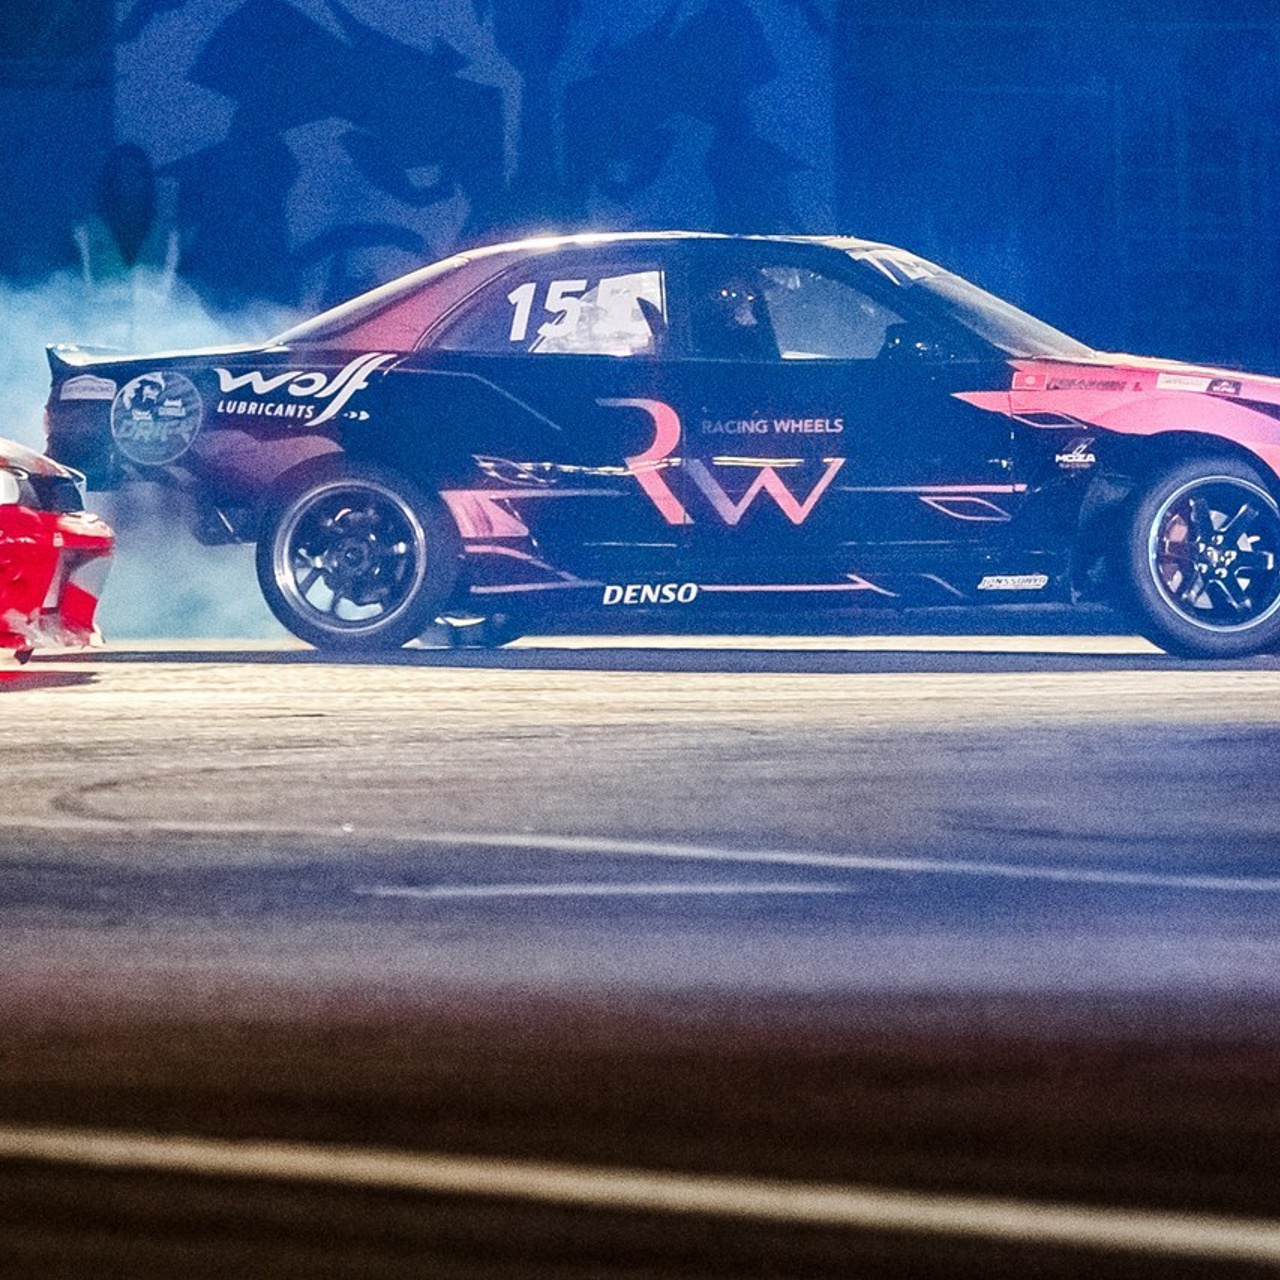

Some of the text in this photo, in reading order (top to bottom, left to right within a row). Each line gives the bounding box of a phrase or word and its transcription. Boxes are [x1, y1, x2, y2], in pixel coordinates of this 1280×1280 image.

[217, 400, 315, 419] LUBRICANTS
[701, 419, 843, 434] RACING WHEELS
[602, 583, 699, 605] DENSO
